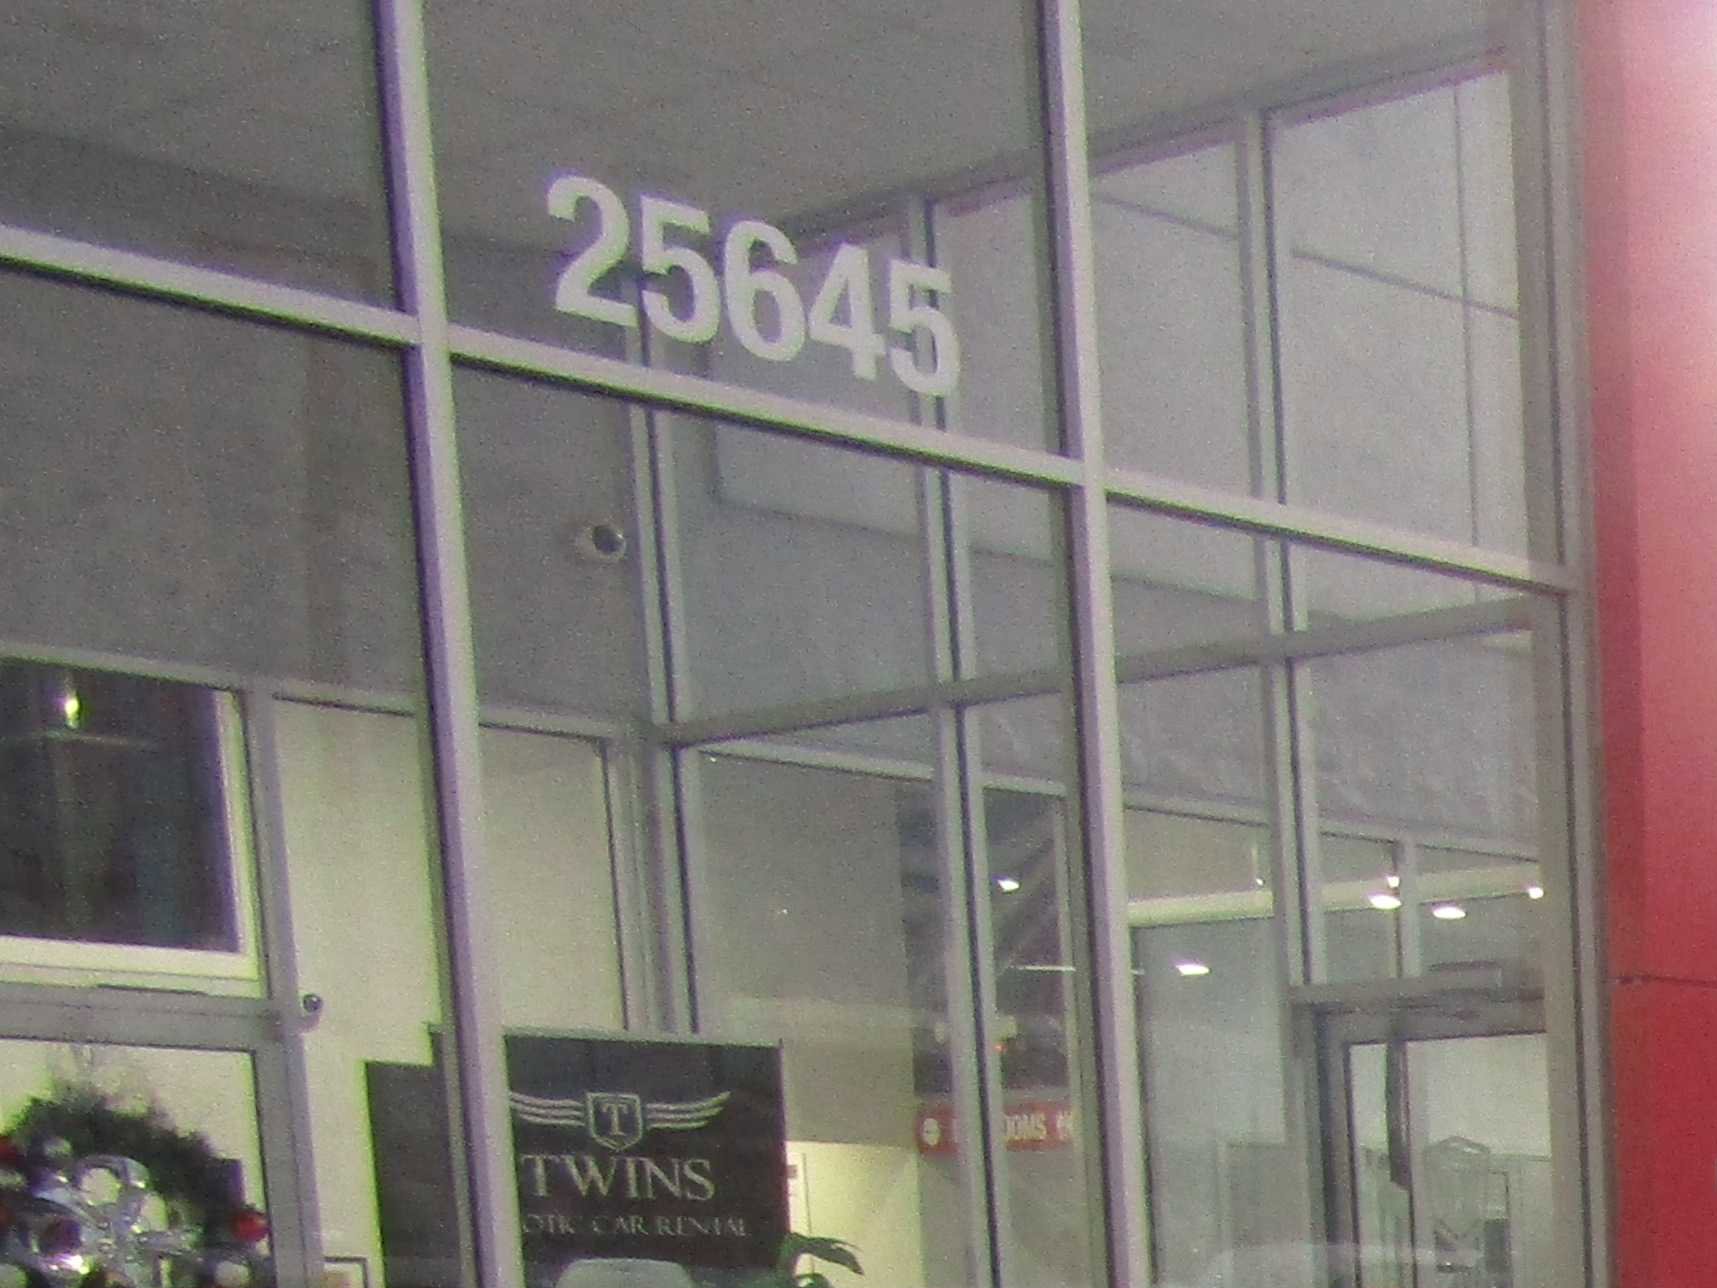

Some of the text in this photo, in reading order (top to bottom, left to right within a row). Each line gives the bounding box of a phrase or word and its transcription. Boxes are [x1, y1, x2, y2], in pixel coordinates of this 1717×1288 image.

[547, 176, 960, 397] 25645
[602, 1103, 631, 1136] T
[520, 1154, 716, 1201] TWINS
[594, 1213, 646, 1236] CAR
